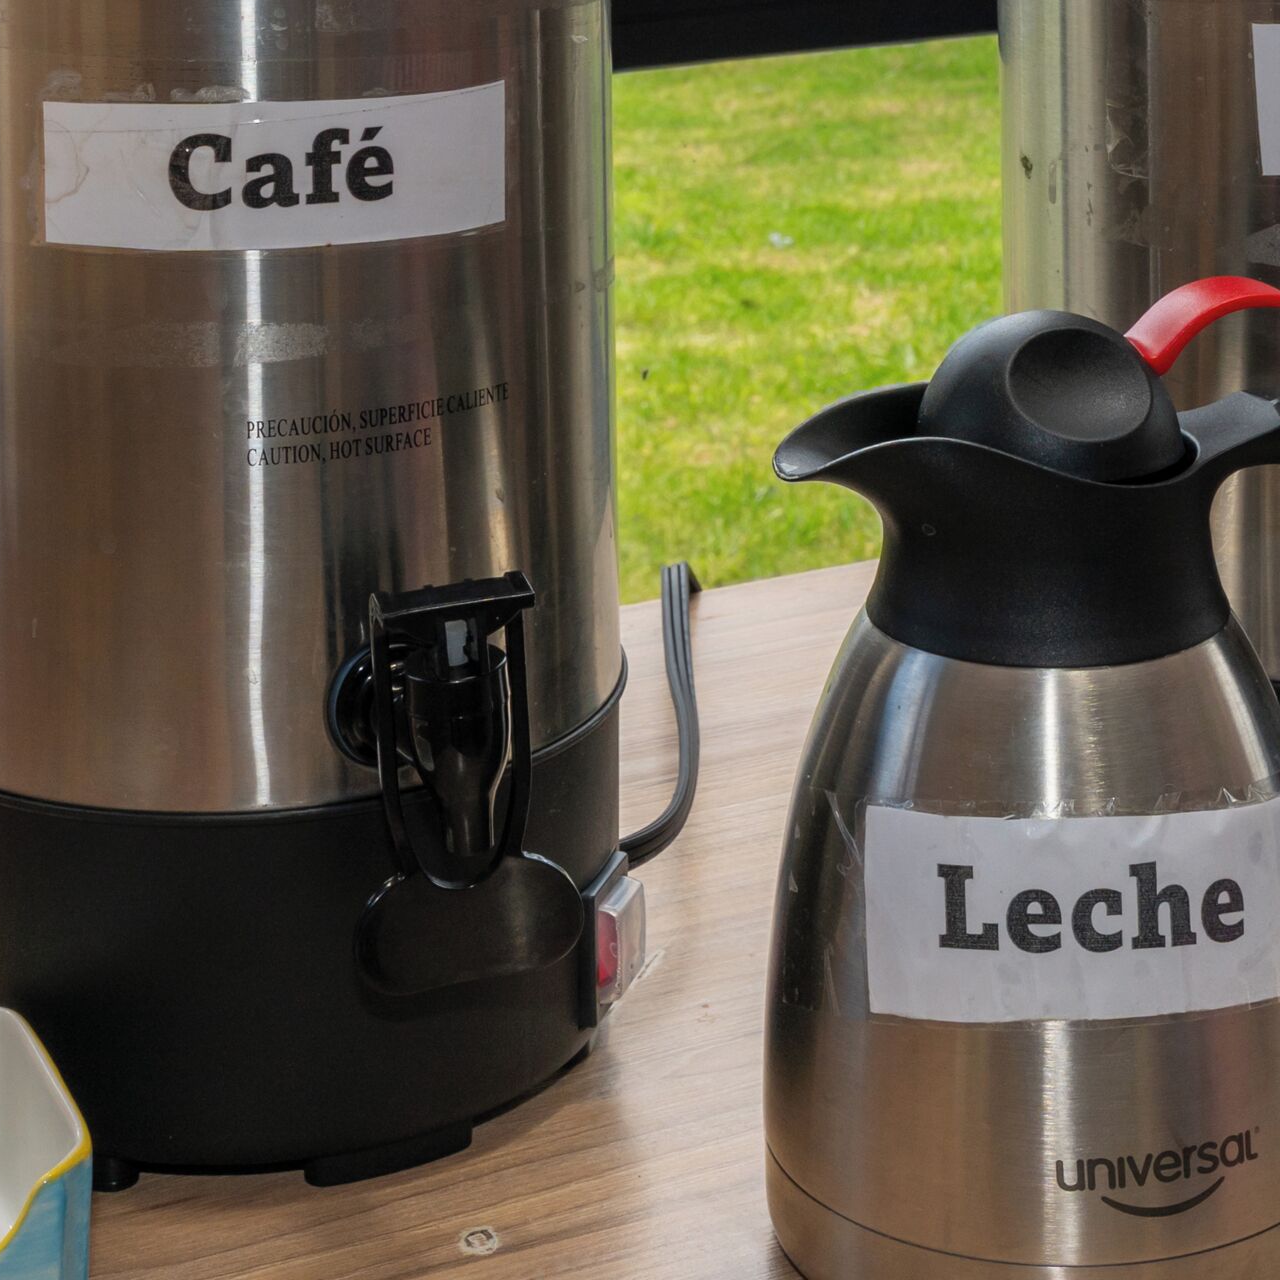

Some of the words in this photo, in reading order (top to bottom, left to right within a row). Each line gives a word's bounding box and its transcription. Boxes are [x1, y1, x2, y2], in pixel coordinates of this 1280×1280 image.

[168, 125, 395, 211] Café
[359, 400, 444, 429] SUPERFICIE
[446, 382, 509, 413] CALIENTE
[246, 443, 327, 467] CAUTION,
[329, 438, 363, 461] HOT
[364, 427, 432, 456] SURFACE
[937, 861, 1244, 953] Leche
[1056, 1129, 1259, 1192] universal
